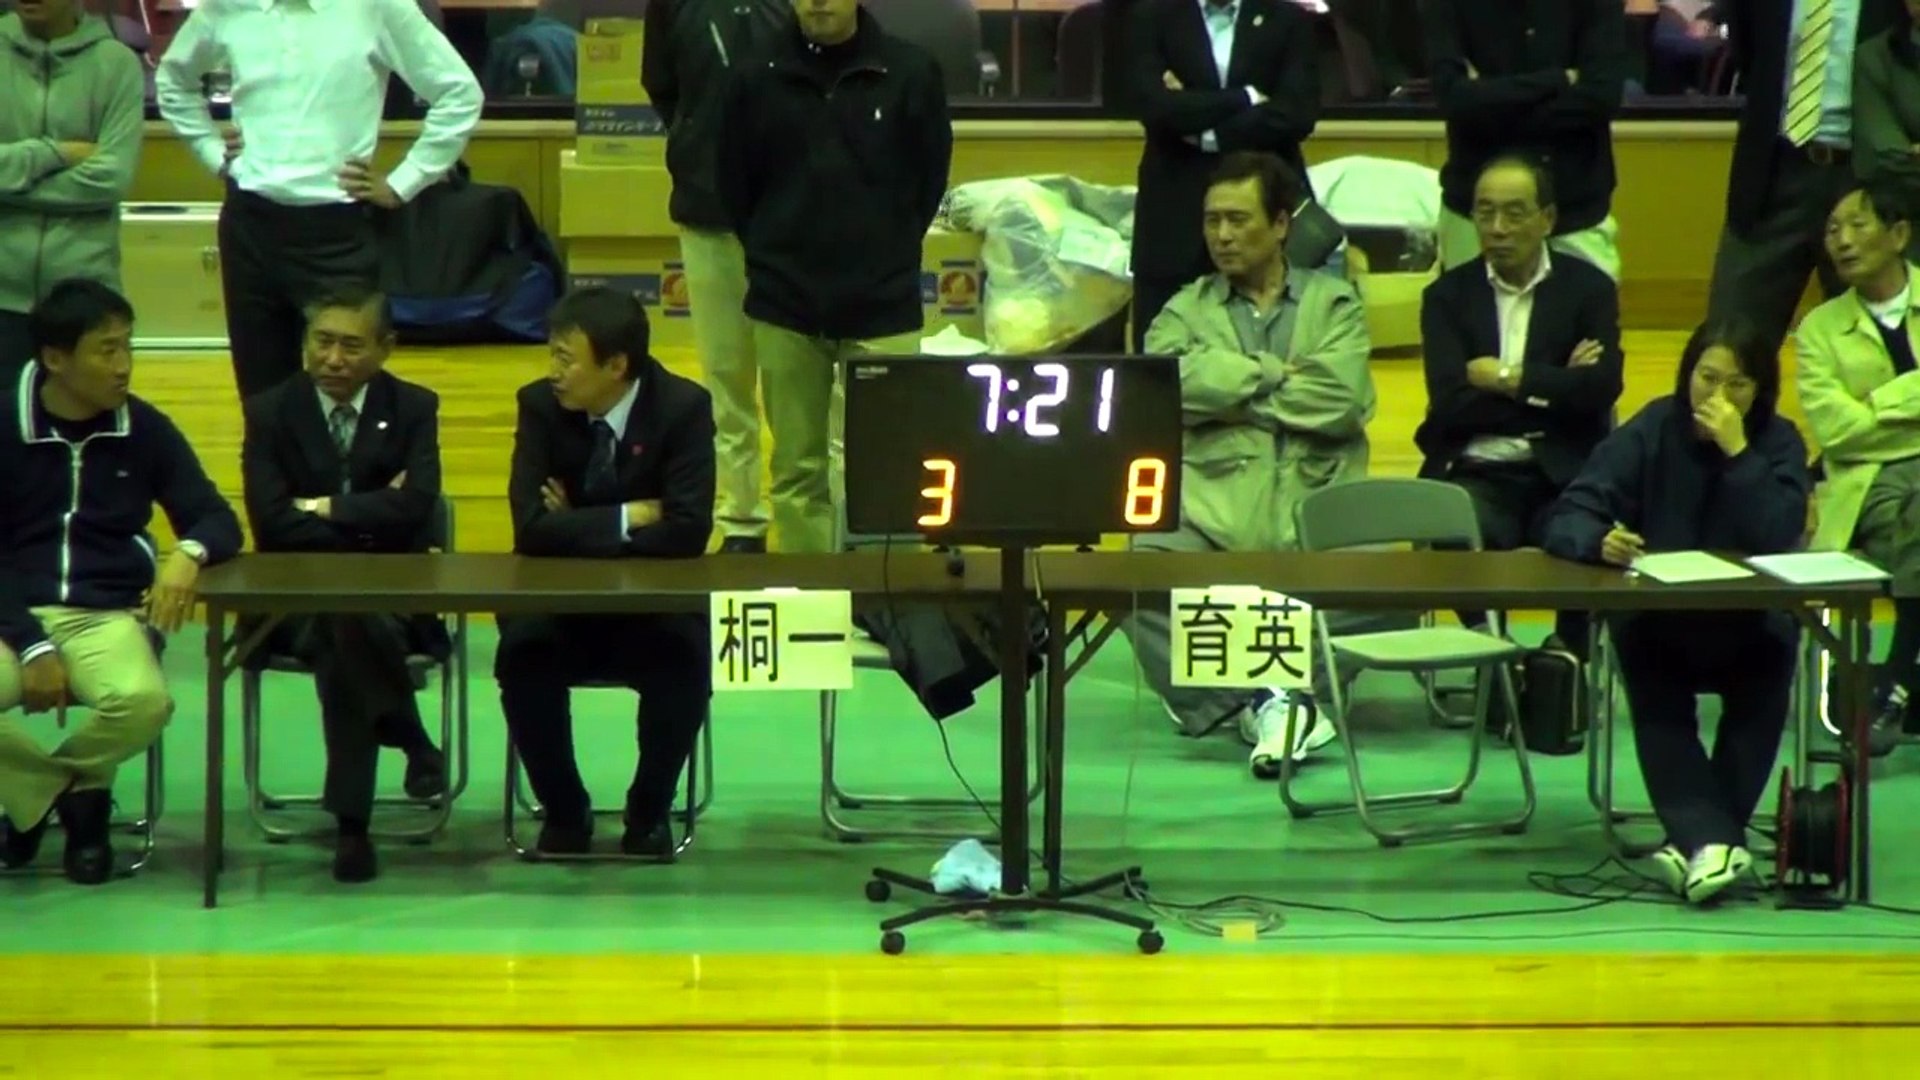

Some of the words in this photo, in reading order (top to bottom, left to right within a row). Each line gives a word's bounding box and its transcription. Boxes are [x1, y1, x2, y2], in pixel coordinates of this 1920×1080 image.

[966, 362, 1115, 437] 7:21
[917, 458, 957, 527] 3
[1123, 457, 1167, 526] 8
[718, 598, 846, 684] 桐一
[1177, 595, 1305, 680] 育英
